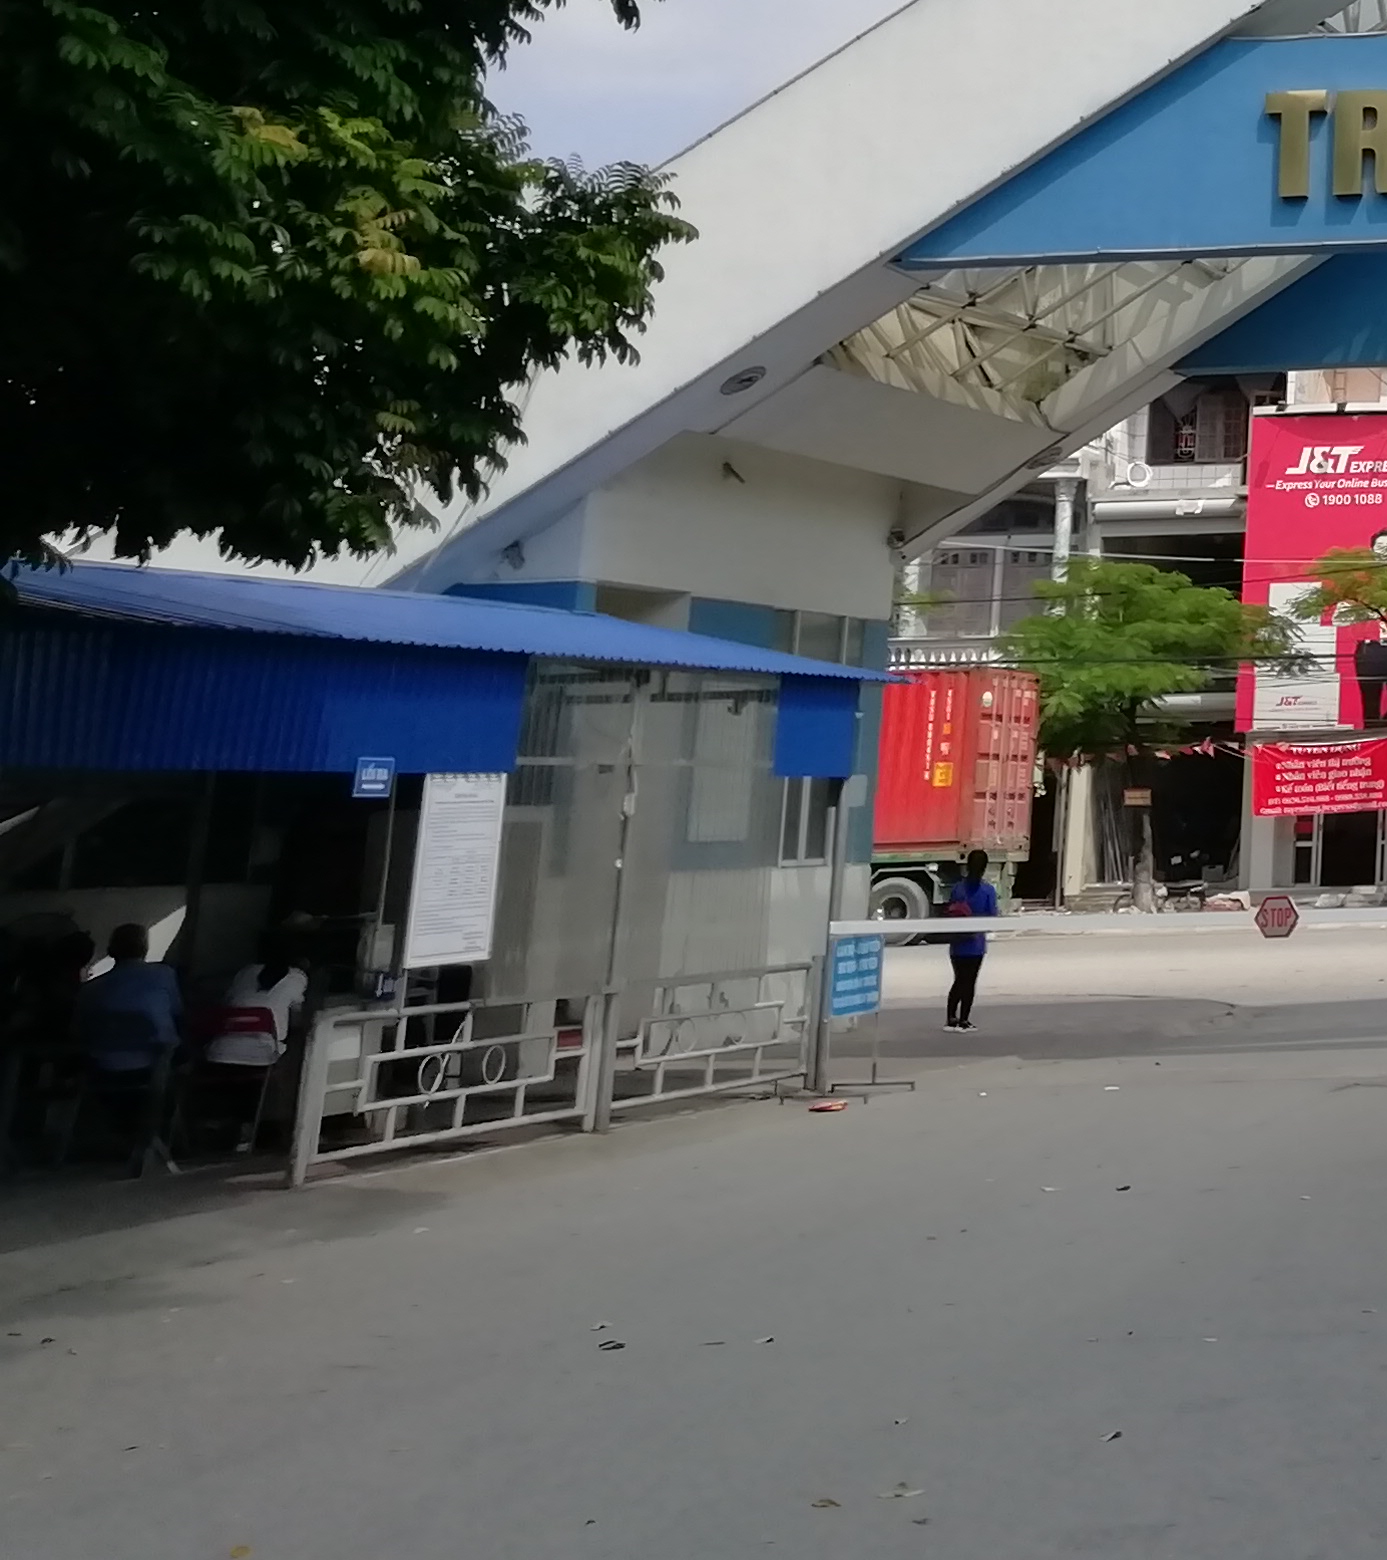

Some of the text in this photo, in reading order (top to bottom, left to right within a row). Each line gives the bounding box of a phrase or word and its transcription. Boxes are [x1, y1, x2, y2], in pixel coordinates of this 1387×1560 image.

[1285, 446, 1364, 475] J&T
[1275, 480, 1312, 492] Express
[1337, 478, 1369, 489] Online
[1323, 494, 1351, 506] 1900
[1260, 907, 1292, 928] STOP
